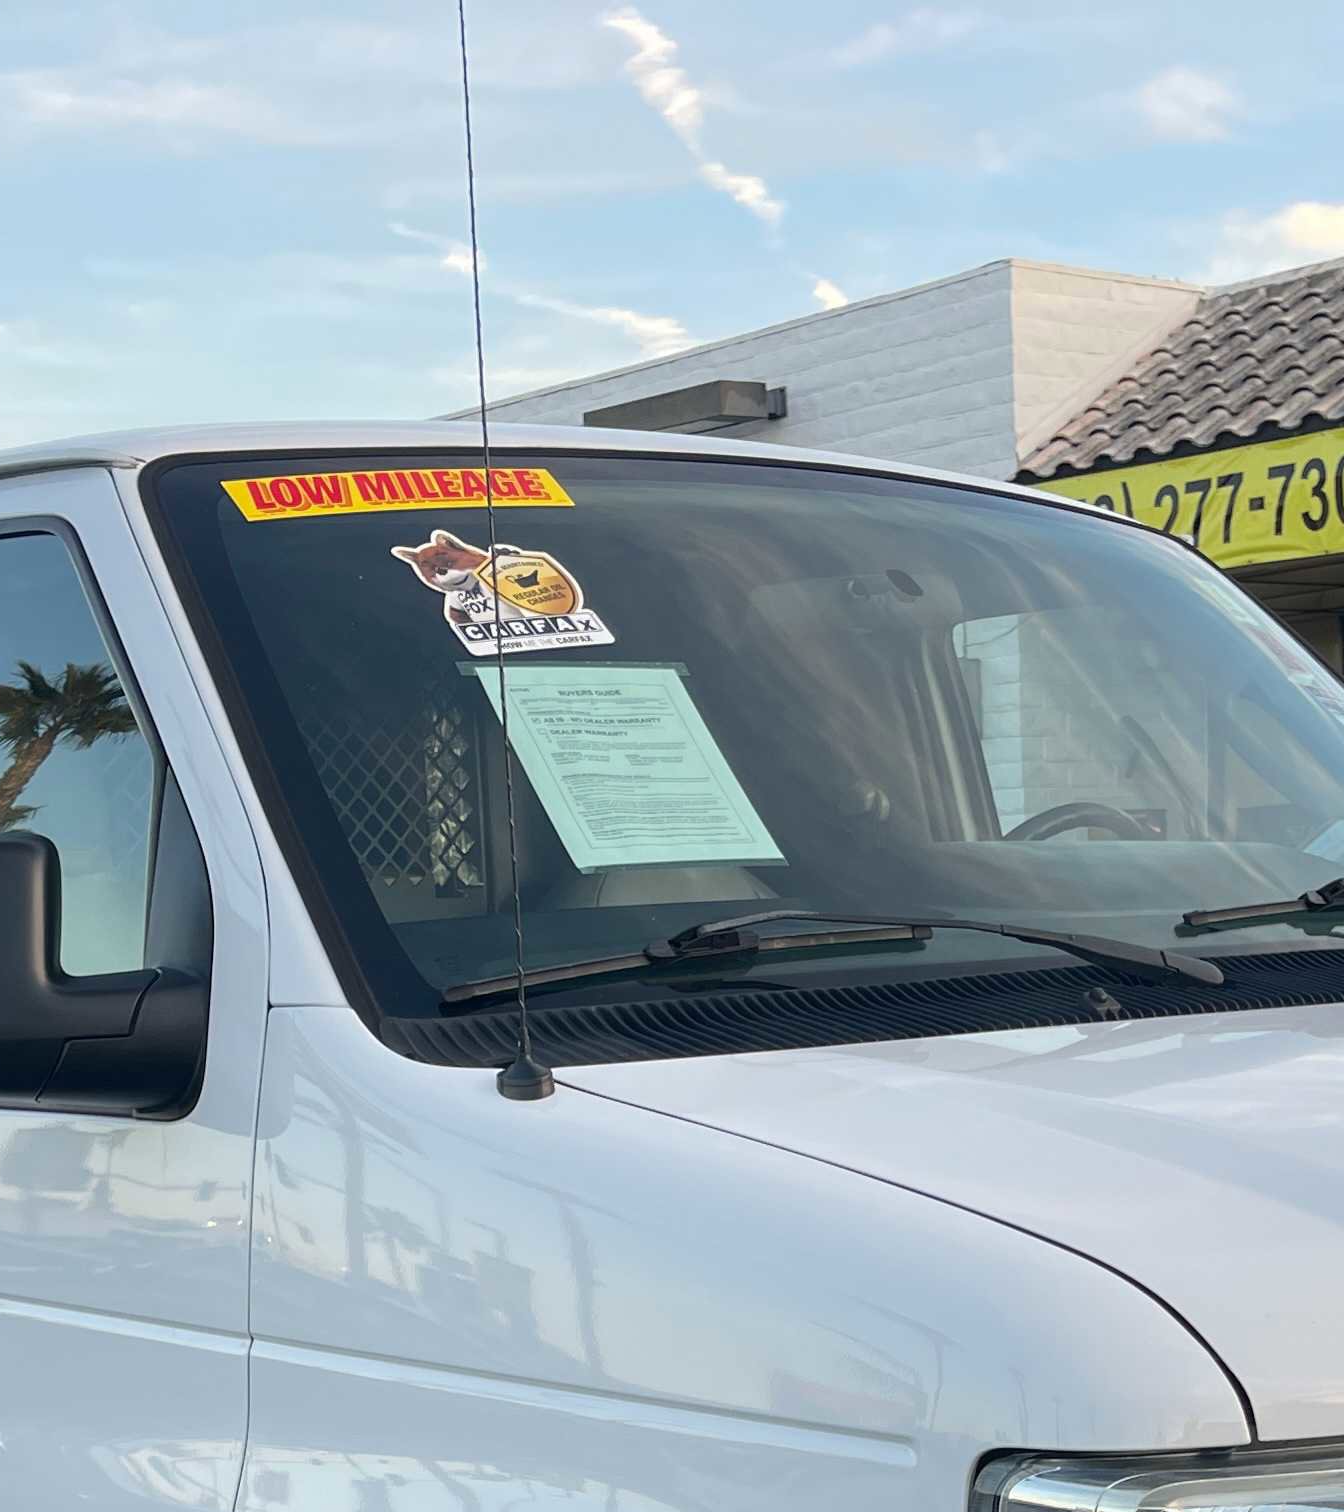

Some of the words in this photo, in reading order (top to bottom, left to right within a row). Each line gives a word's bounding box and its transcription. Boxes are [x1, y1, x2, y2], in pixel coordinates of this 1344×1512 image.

[248, 474, 338, 511] LOW
[351, 468, 542, 502] MILEAGE
[457, 587, 486, 604] CAR
[464, 599, 495, 614] FOX
[464, 616, 597, 640] CARFAX
